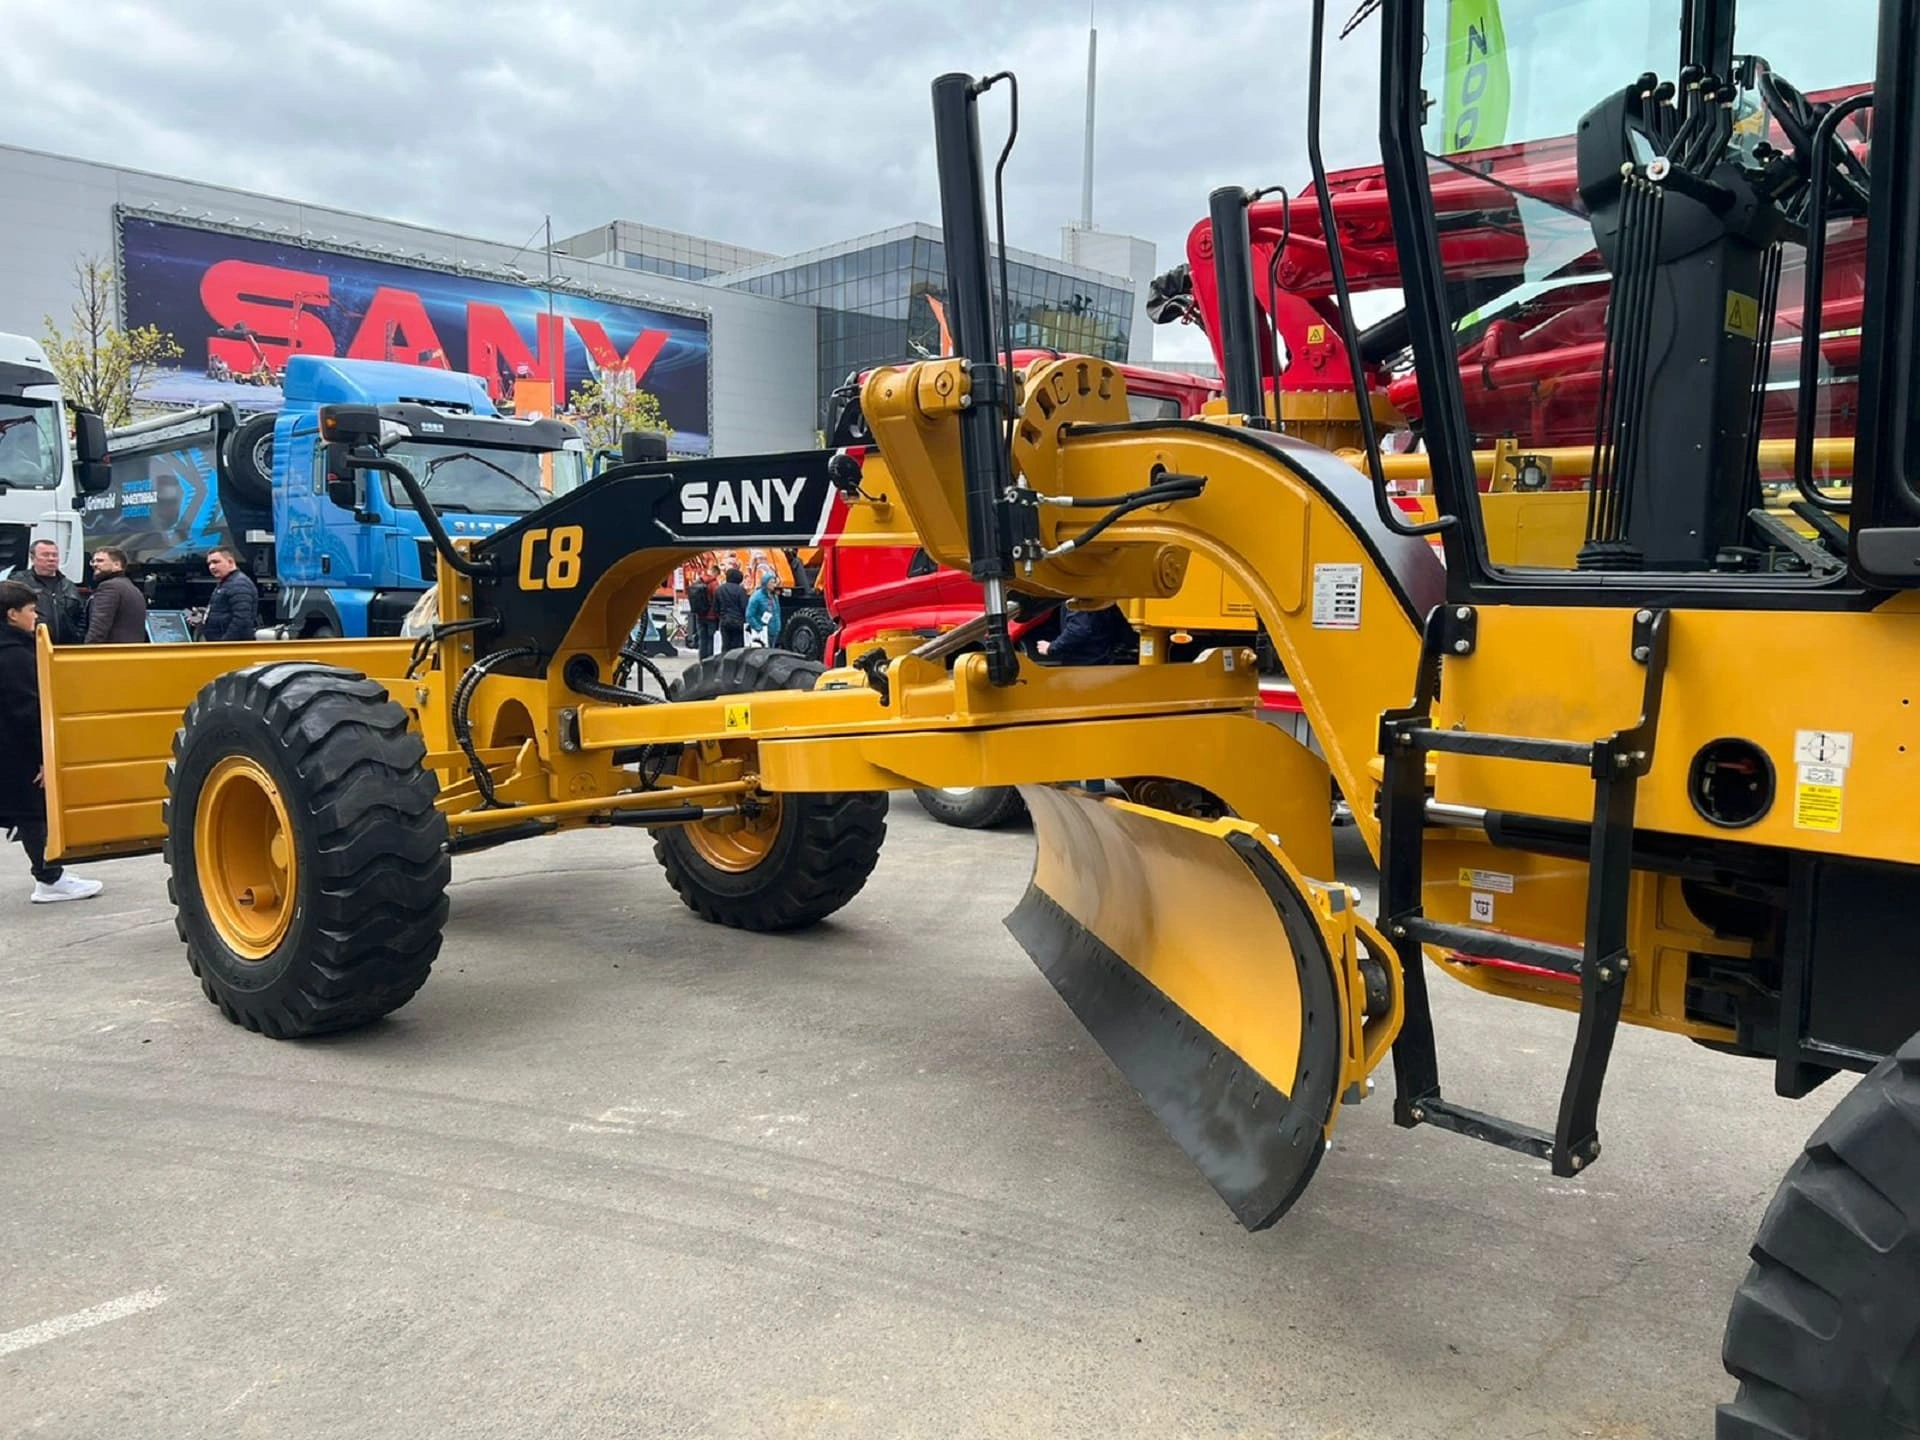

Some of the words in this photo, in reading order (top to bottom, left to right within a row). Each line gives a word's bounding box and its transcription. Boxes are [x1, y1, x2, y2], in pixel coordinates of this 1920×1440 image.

[199, 258, 671, 406] SANY
[679, 477, 807, 525] SANY
[517, 524, 584, 591] C8
